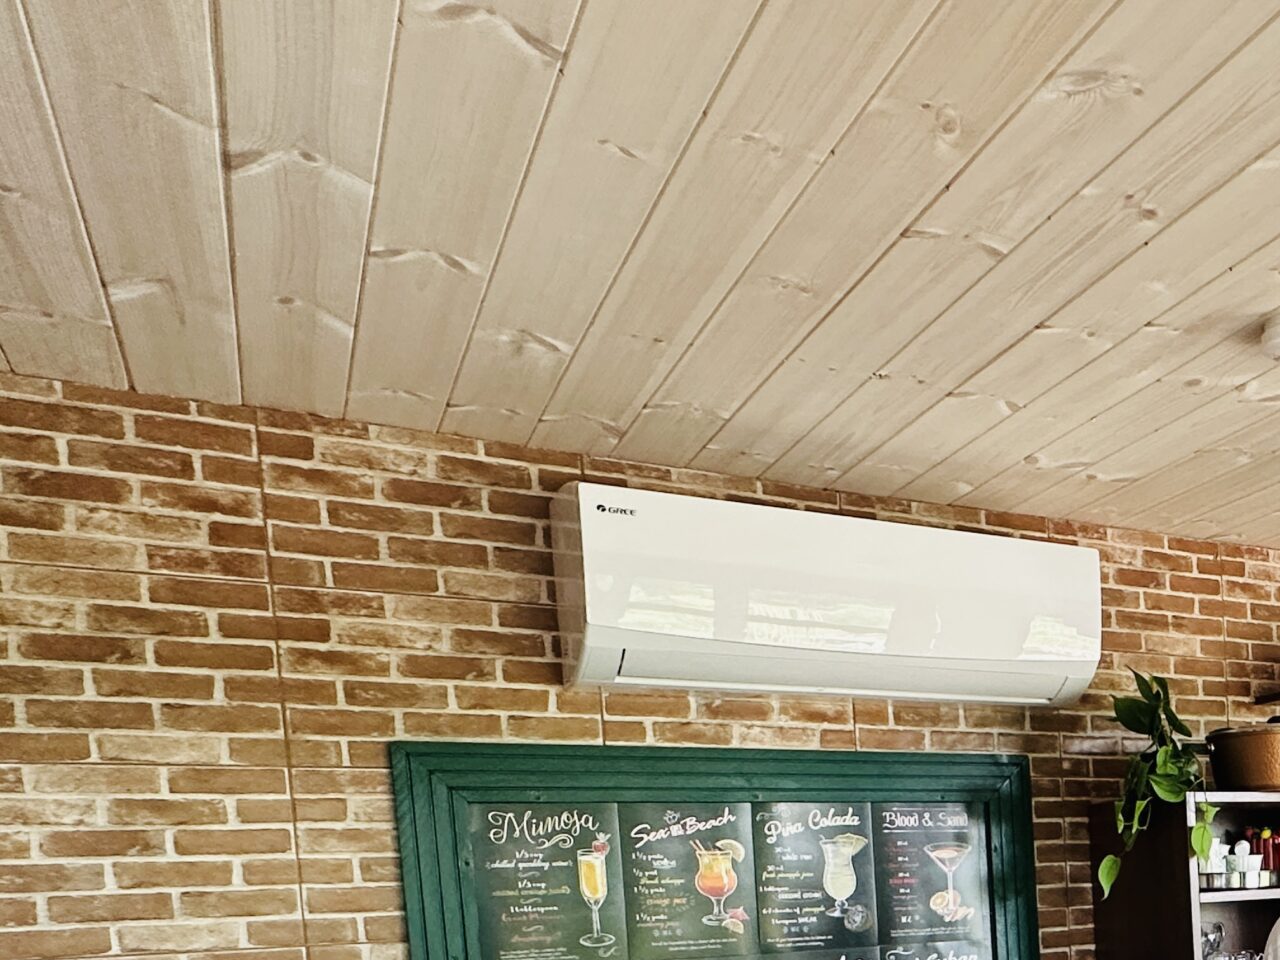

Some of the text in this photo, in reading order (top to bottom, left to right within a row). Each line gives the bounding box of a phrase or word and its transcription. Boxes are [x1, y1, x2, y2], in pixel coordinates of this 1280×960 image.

[488, 810, 599, 844] Mimosa
[681, 807, 736, 834] Beach
[808, 807, 861, 830] Colada
[882, 812, 968, 828] Blood & Sand
